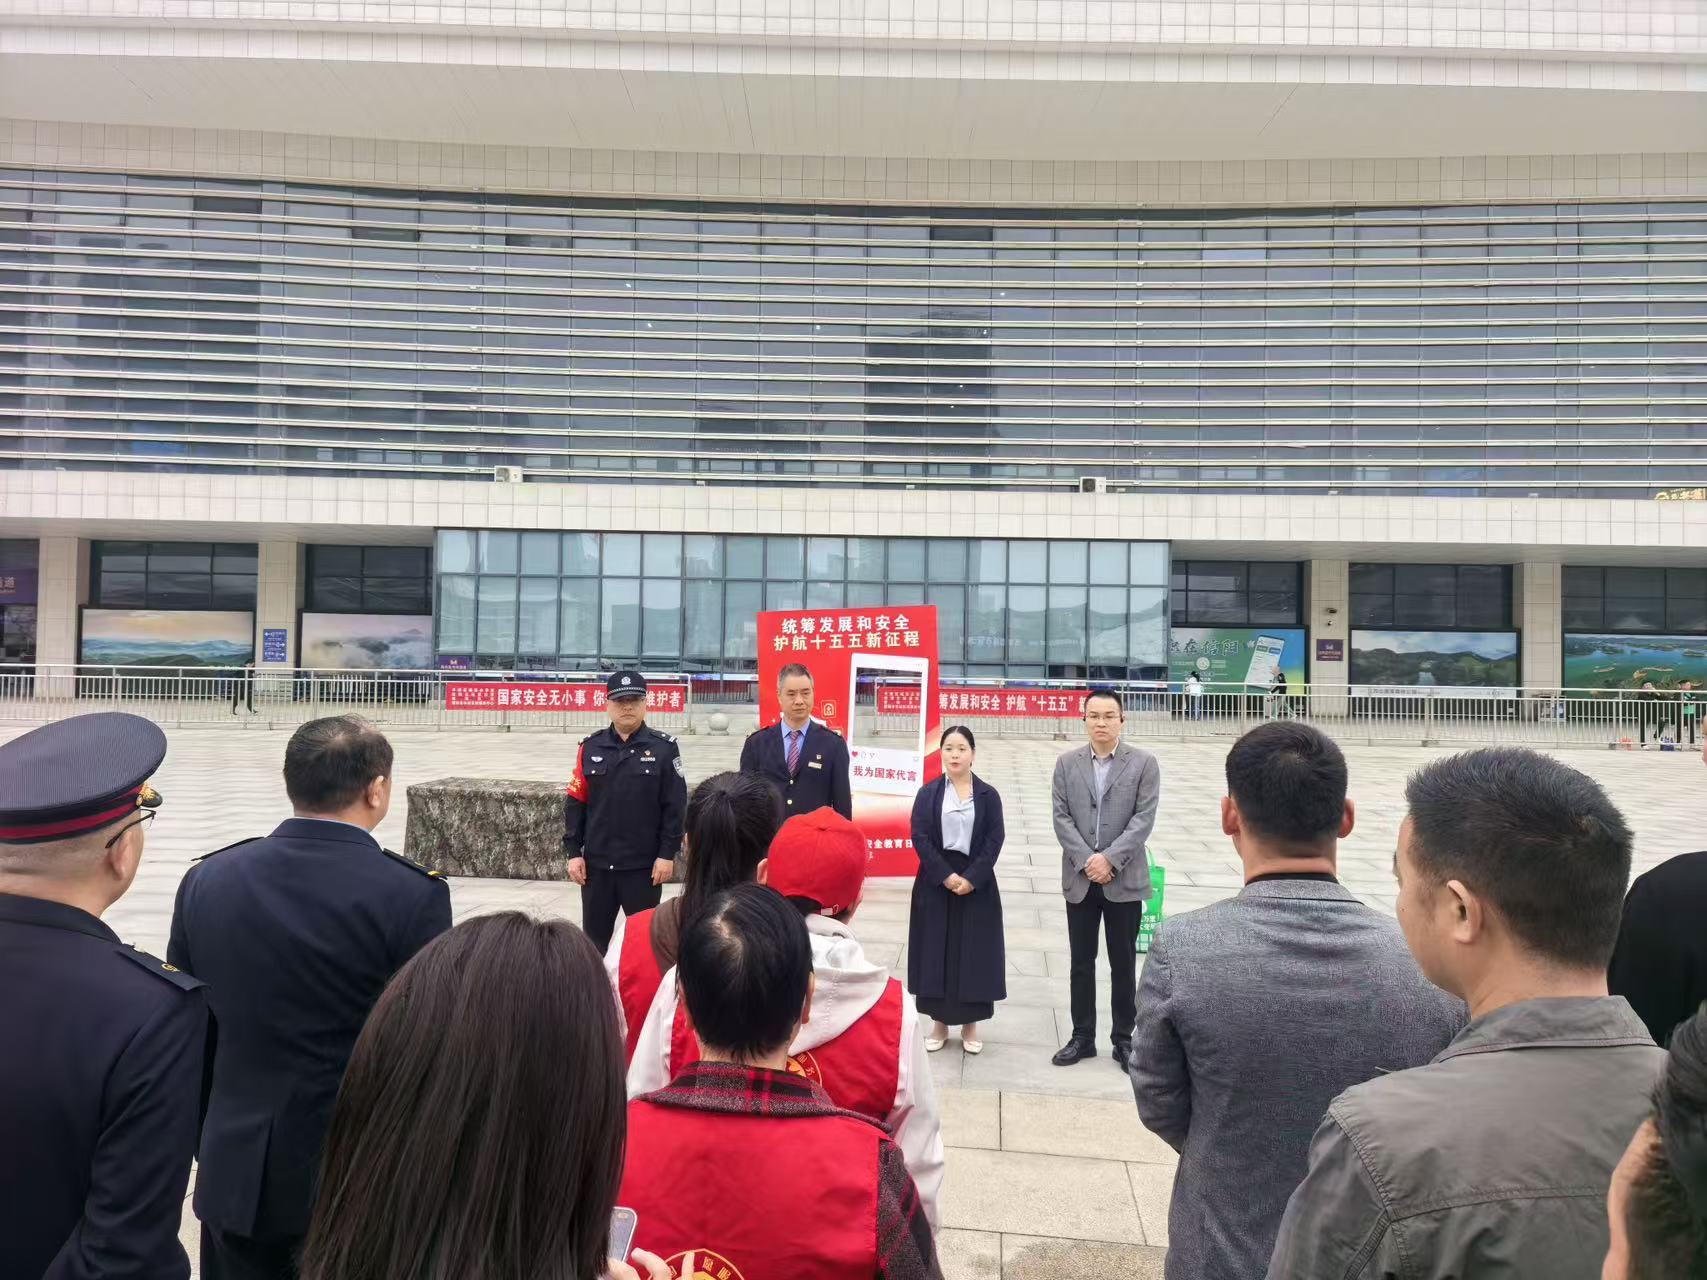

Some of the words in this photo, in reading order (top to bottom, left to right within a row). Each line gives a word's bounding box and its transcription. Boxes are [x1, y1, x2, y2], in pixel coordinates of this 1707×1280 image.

[781, 614, 910, 635] 统筹发展和安全
[774, 631, 920, 651] 护航十五五新征程
[497, 688, 586, 706] 国家安全无小事
[853, 765, 917, 782] 我为国家代言
